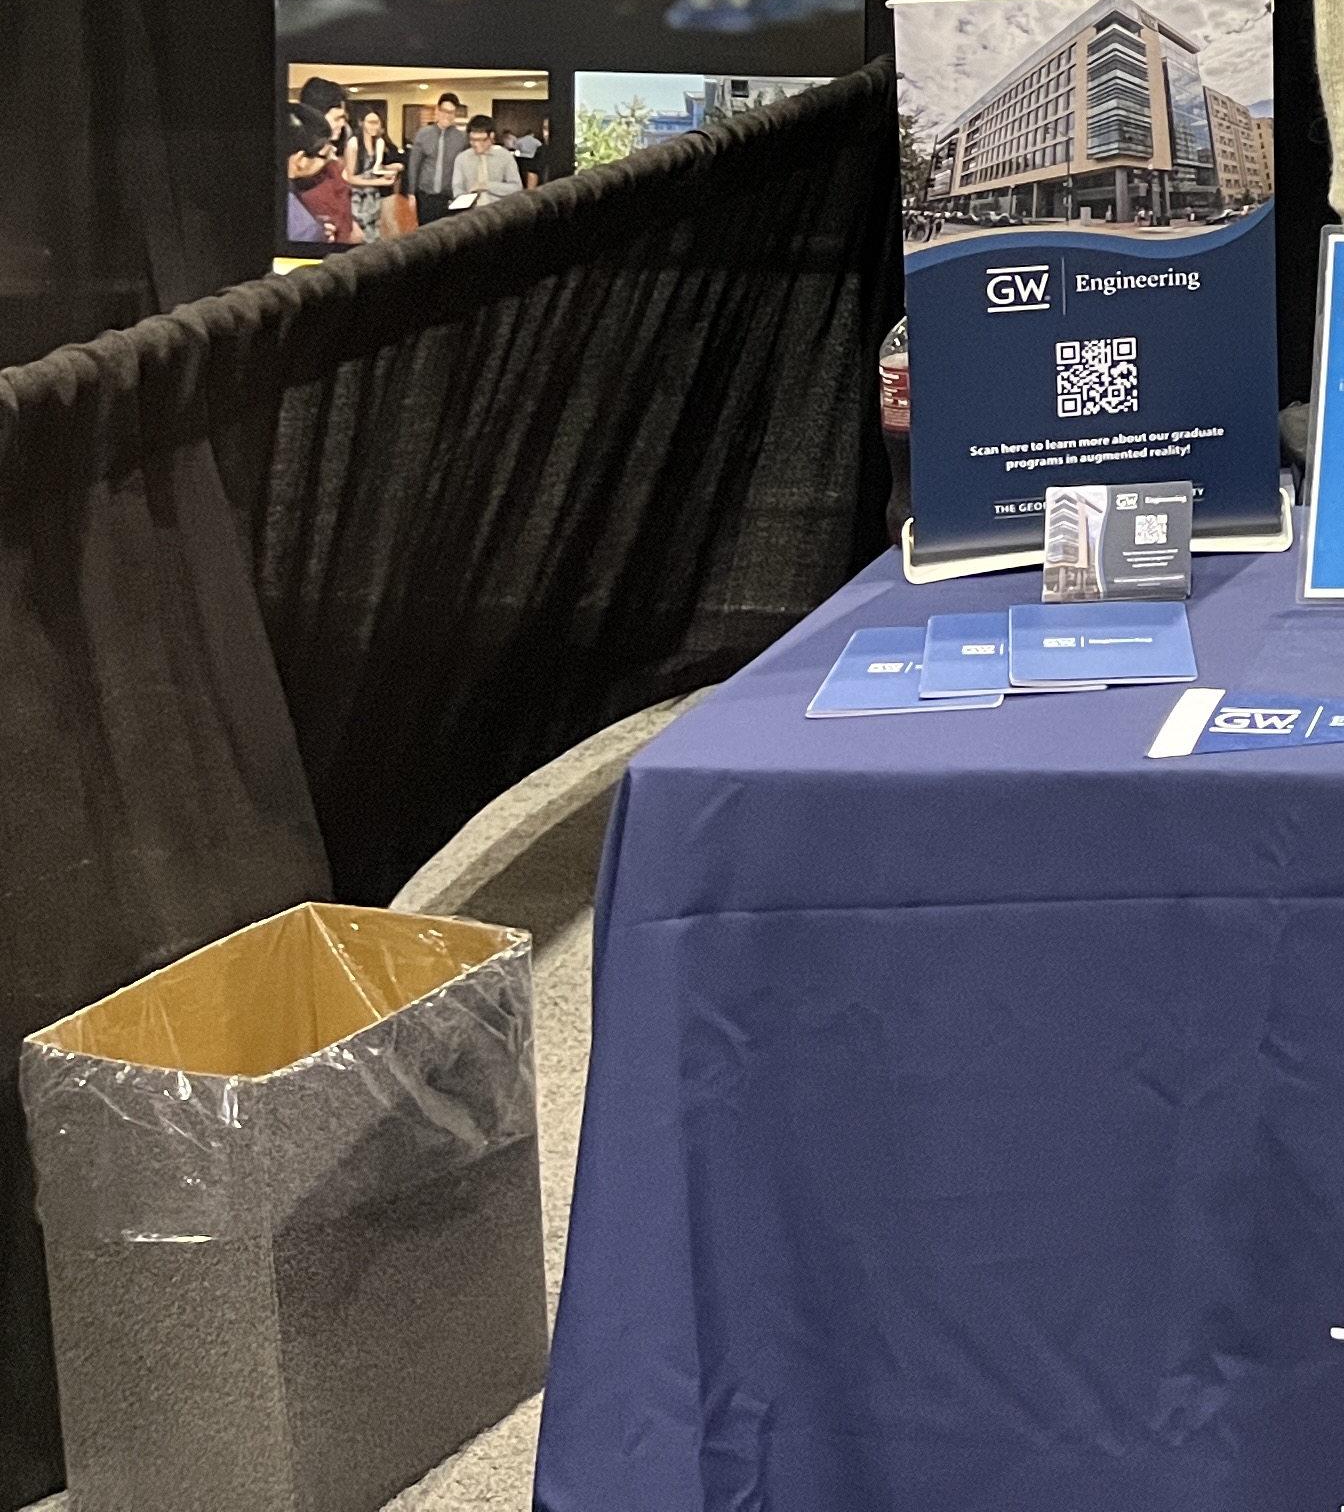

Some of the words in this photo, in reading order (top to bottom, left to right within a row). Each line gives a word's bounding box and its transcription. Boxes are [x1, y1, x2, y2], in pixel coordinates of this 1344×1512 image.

[986, 273, 1050, 306] GW
[1075, 267, 1201, 296] Engineering
[970, 444, 1000, 457] Scan
[1001, 442, 1029, 454] here
[1030, 441, 1044, 452] to
[1045, 438, 1077, 451] learn
[1078, 437, 1110, 448] more
[1111, 433, 1147, 445] about
[1148, 431, 1170, 442] our
[1171, 426, 1225, 442] graduate
[1006, 454, 1064, 472] programs
[1066, 453, 1078, 464] in
[1079, 447, 1148, 466] augmented
[1149, 444, 1192, 460] reality!
[994, 503, 1016, 515] THE
[1214, 711, 1300, 729] GW
